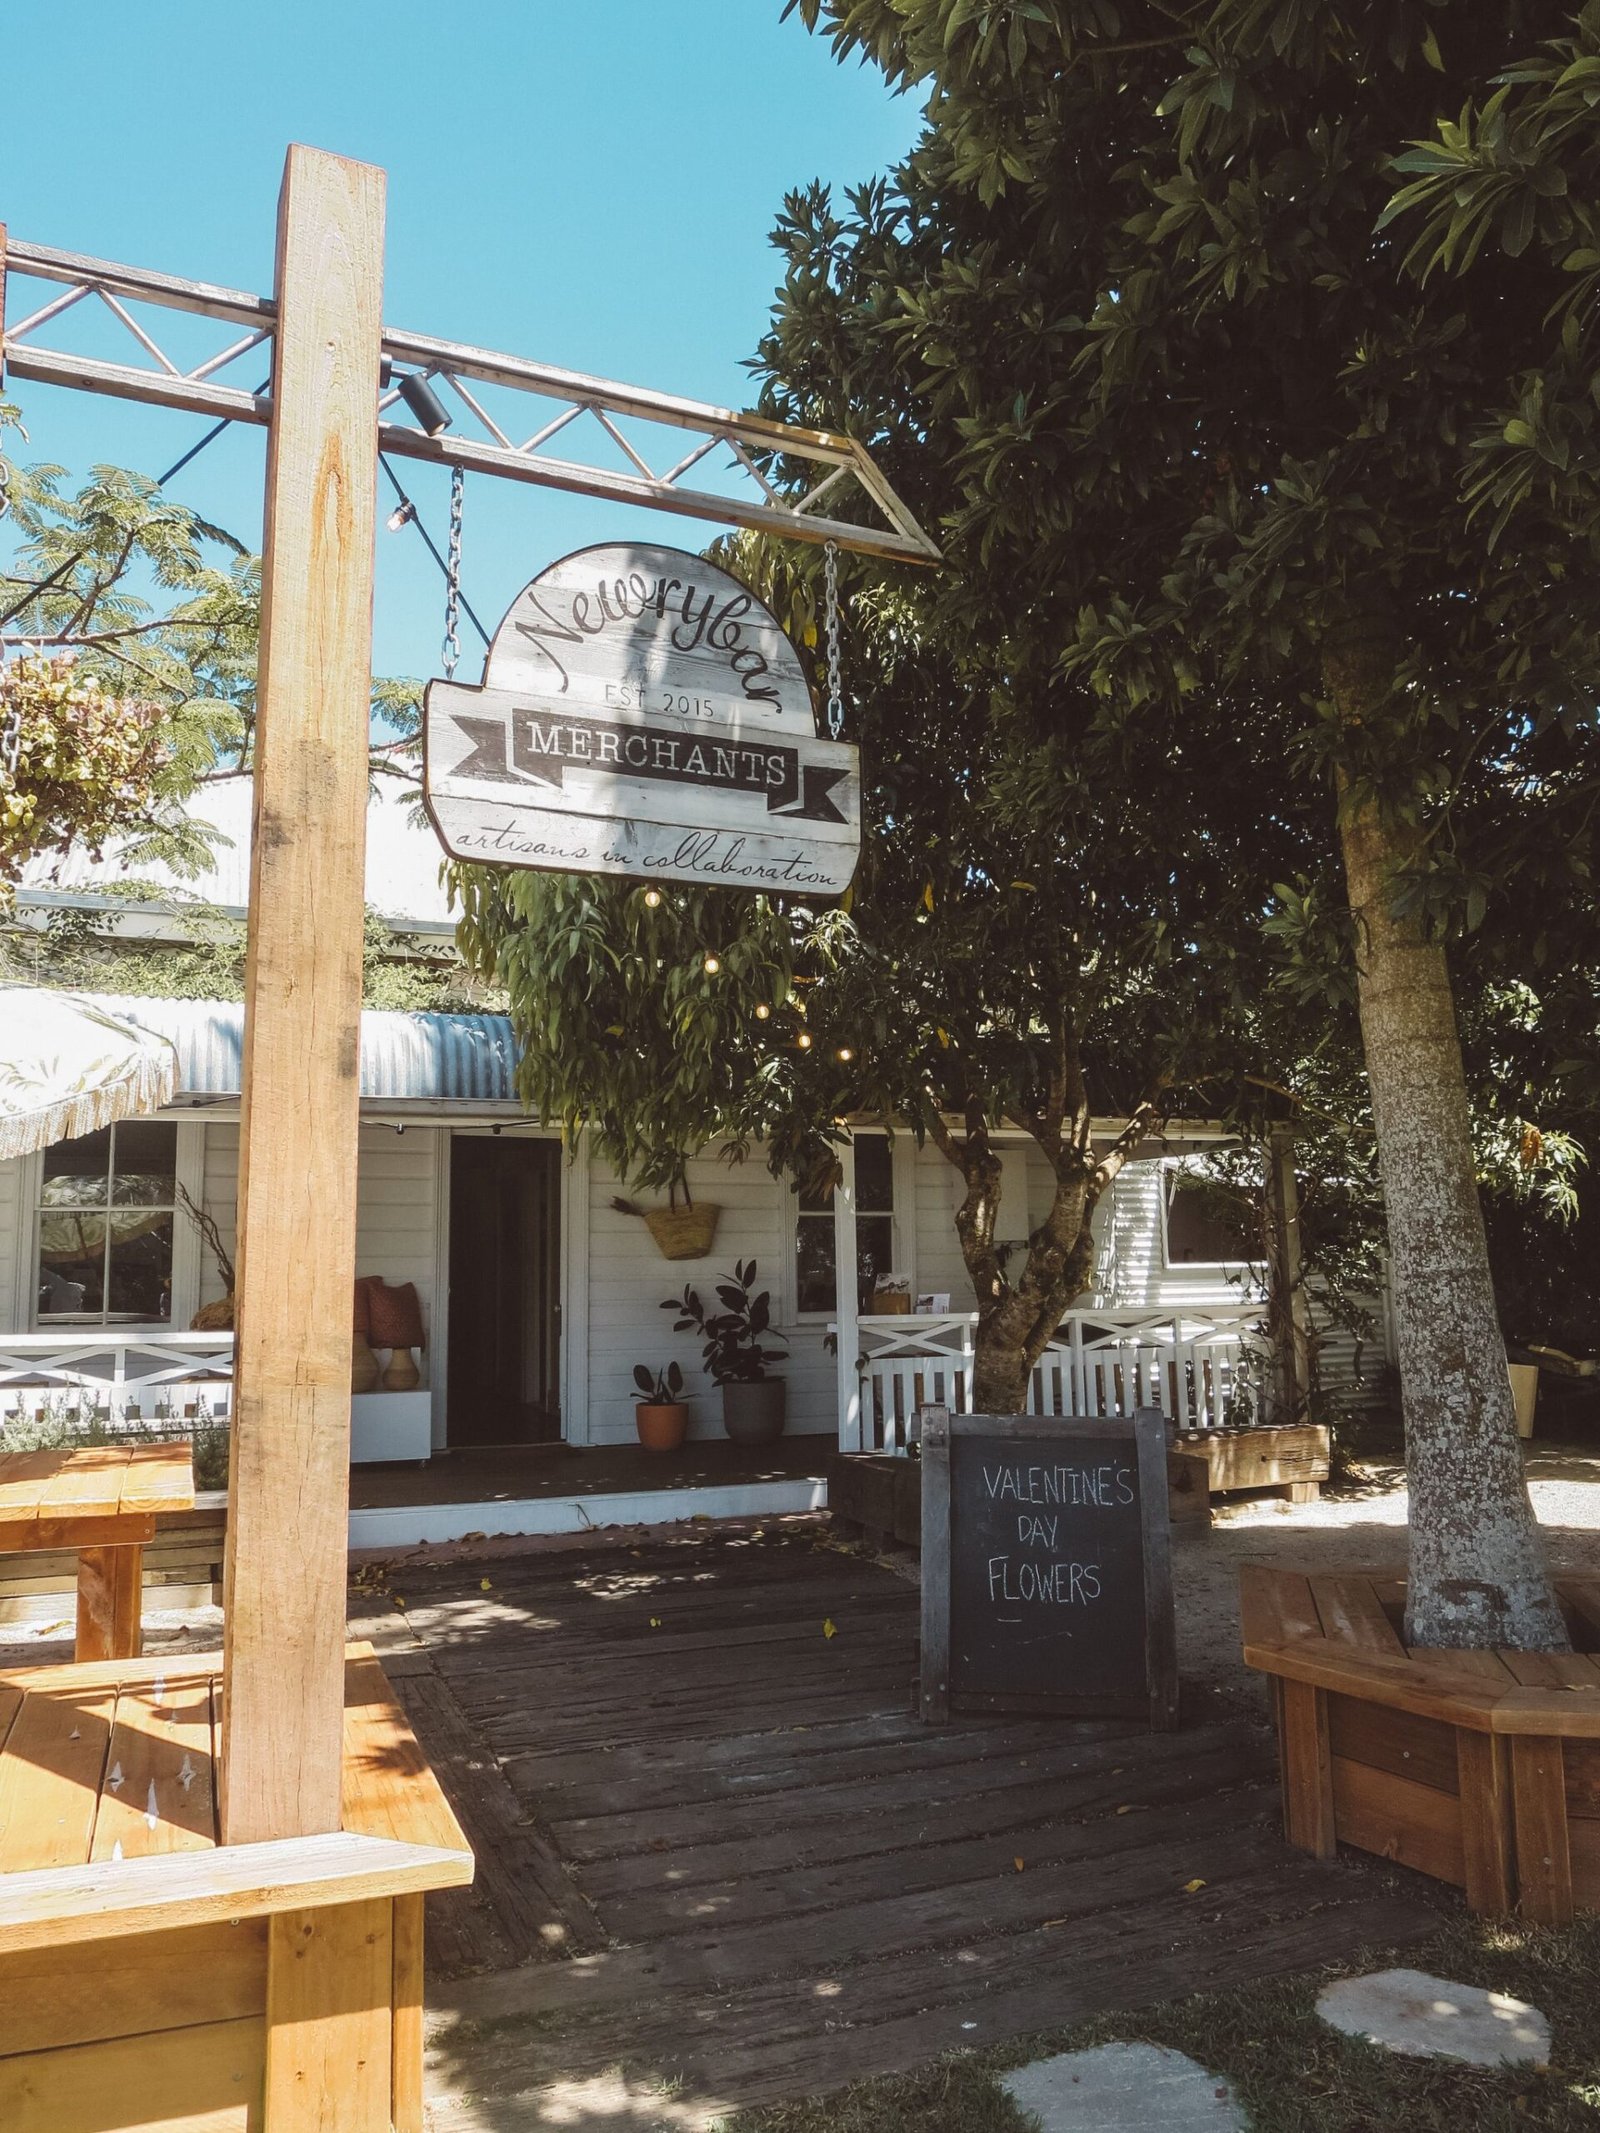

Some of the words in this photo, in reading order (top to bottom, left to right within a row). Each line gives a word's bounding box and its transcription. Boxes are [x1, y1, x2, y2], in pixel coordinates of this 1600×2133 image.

[515, 573, 782, 714] Newrybar
[605, 684, 646, 708] EST
[663, 694, 714, 717] 2015
[526, 720, 787, 786] MERCHANTS
[456, 820, 590, 859] artisans
[601, 849, 634, 865] in
[643, 831, 837, 886] collaboration
[983, 1459, 1134, 1506] VALENTINE'S
[1018, 1515, 1058, 1549] DAY
[989, 1556, 1101, 1605] FLOWERS
